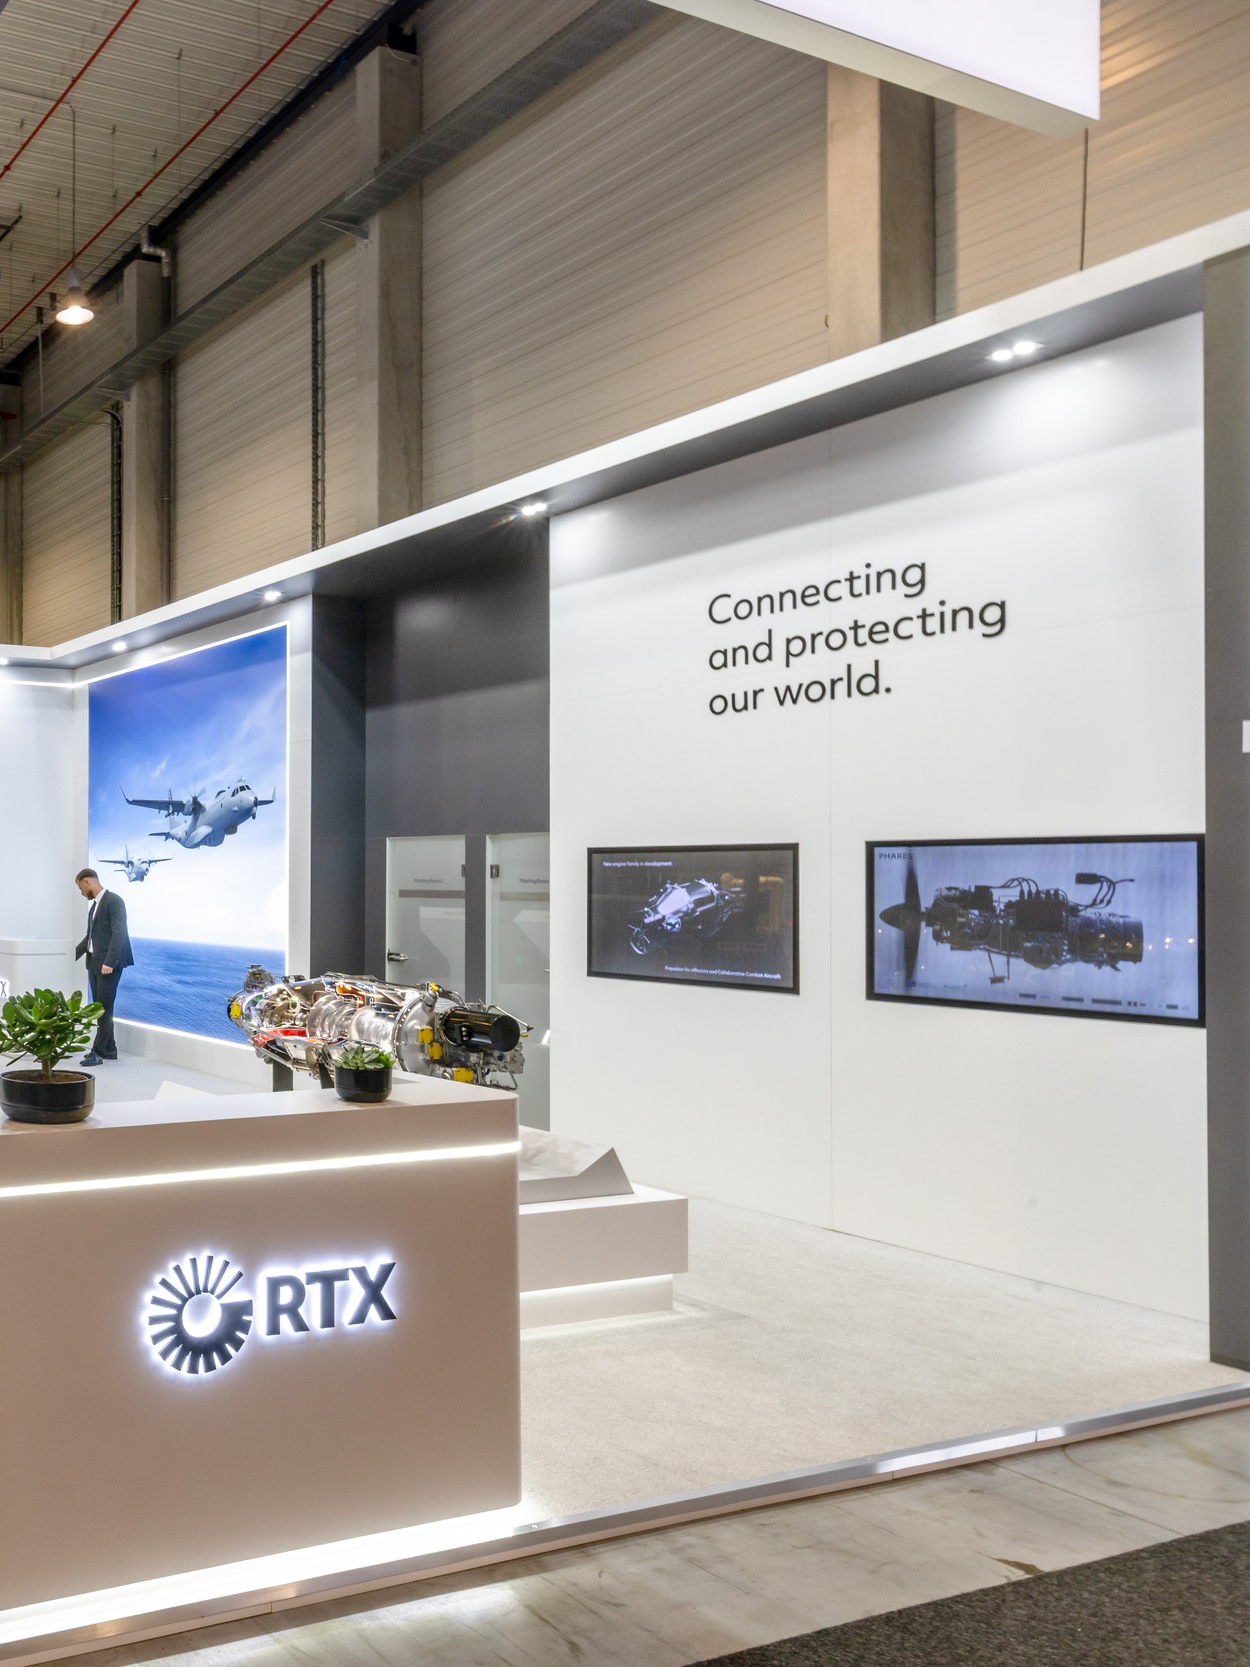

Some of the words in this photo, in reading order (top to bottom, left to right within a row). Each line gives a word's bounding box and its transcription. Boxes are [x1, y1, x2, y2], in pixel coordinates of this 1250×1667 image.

[707, 562, 927, 625] Connecting
[707, 628, 774, 671] and
[784, 599, 1007, 668] protecting
[708, 687, 765, 716] our
[773, 659, 892, 707] world.
[878, 852, 914, 860] PHARES
[763, 972, 782, 980] Aircraft
[265, 1261, 398, 1336] RTX
